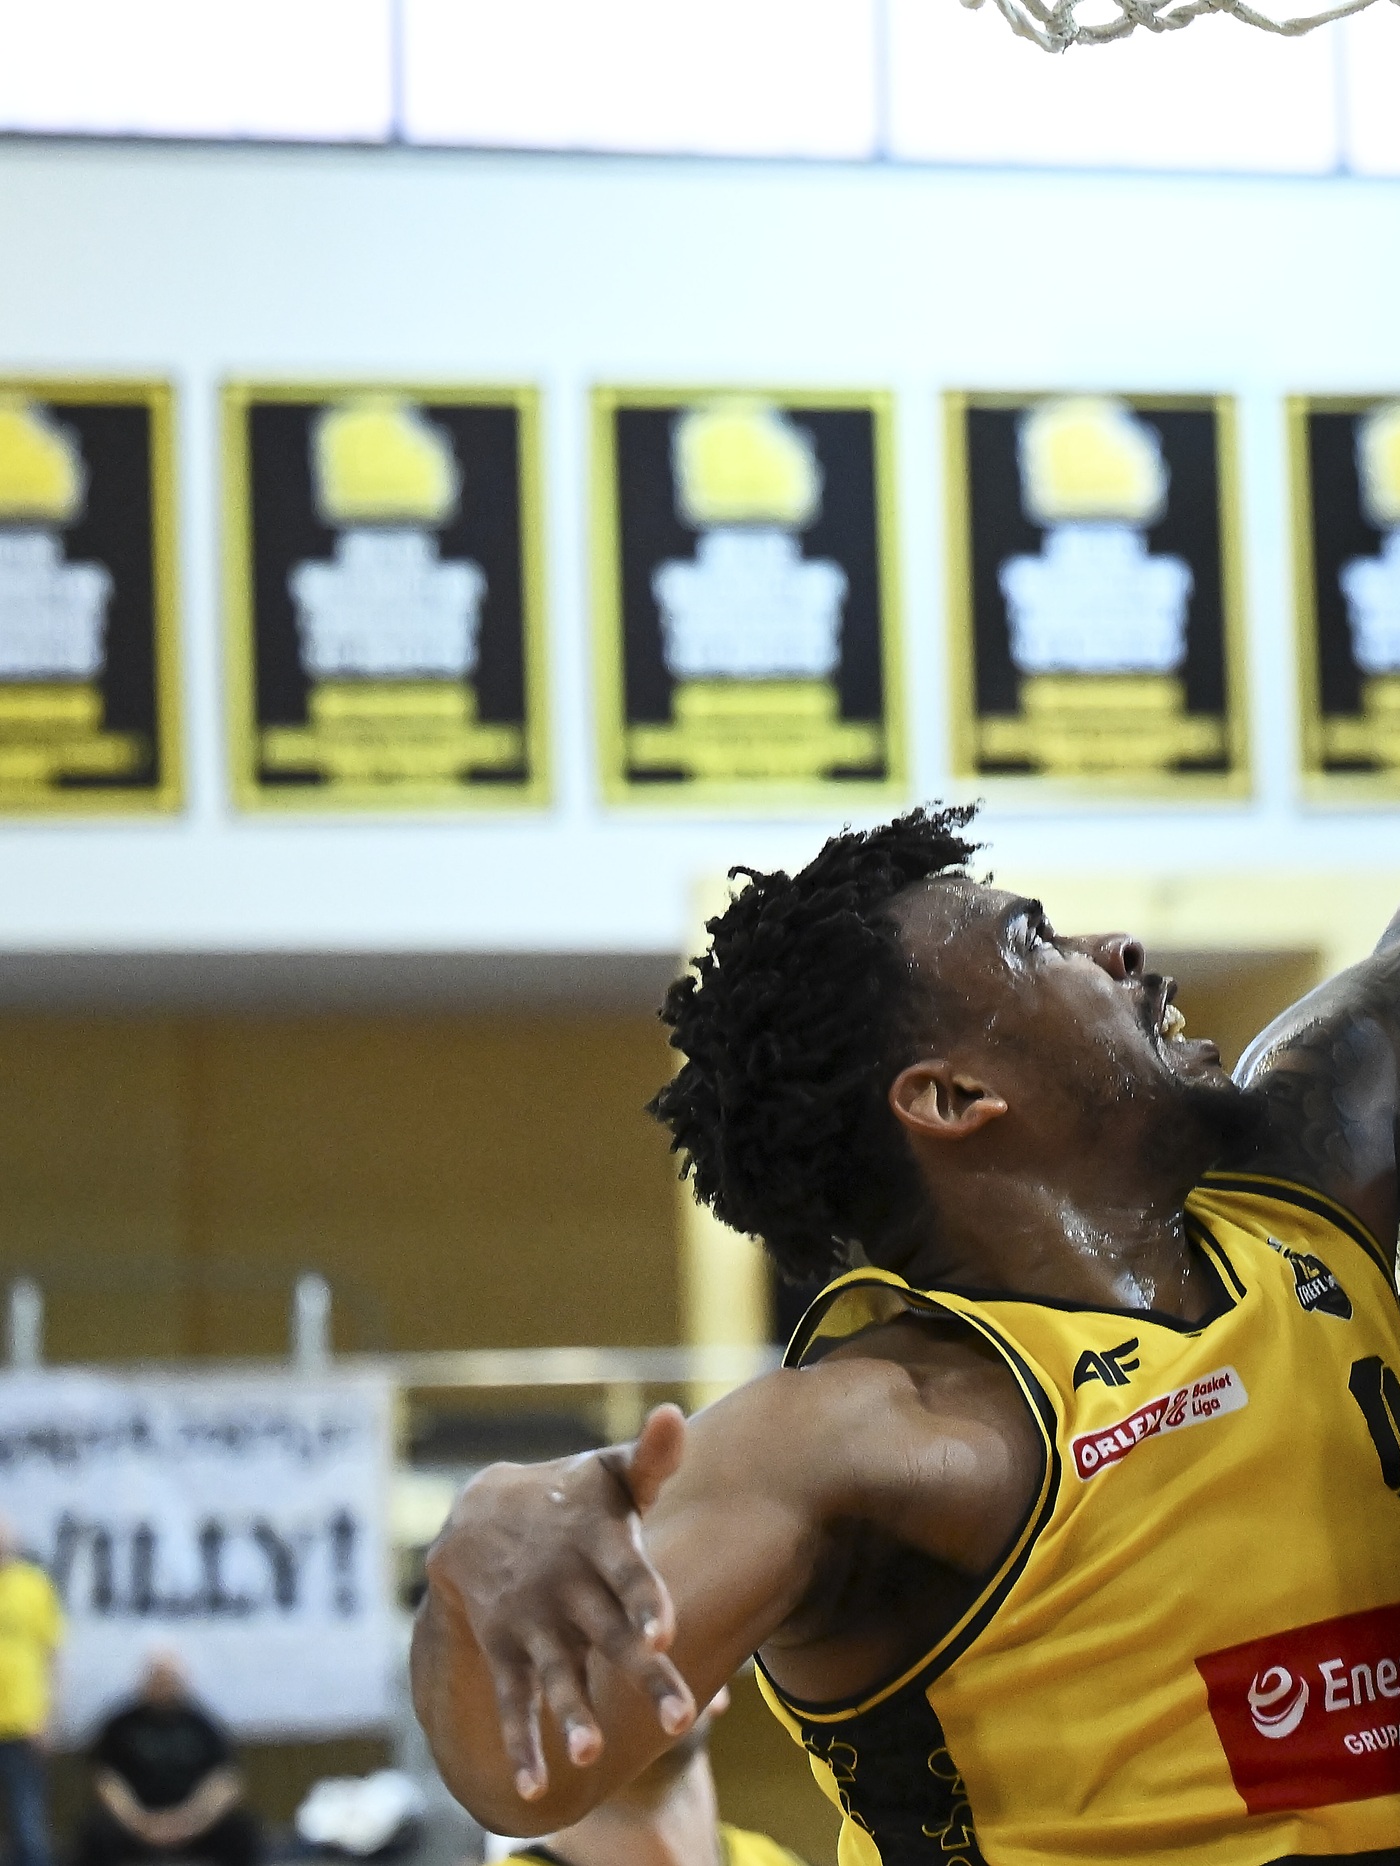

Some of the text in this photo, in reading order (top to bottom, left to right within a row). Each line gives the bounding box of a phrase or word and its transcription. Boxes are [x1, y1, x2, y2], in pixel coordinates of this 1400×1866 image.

[1191, 1372, 1232, 1398] Basket
[1191, 1397, 1221, 1417] Liga
[1081, 1409, 1162, 1469] ORLEN
